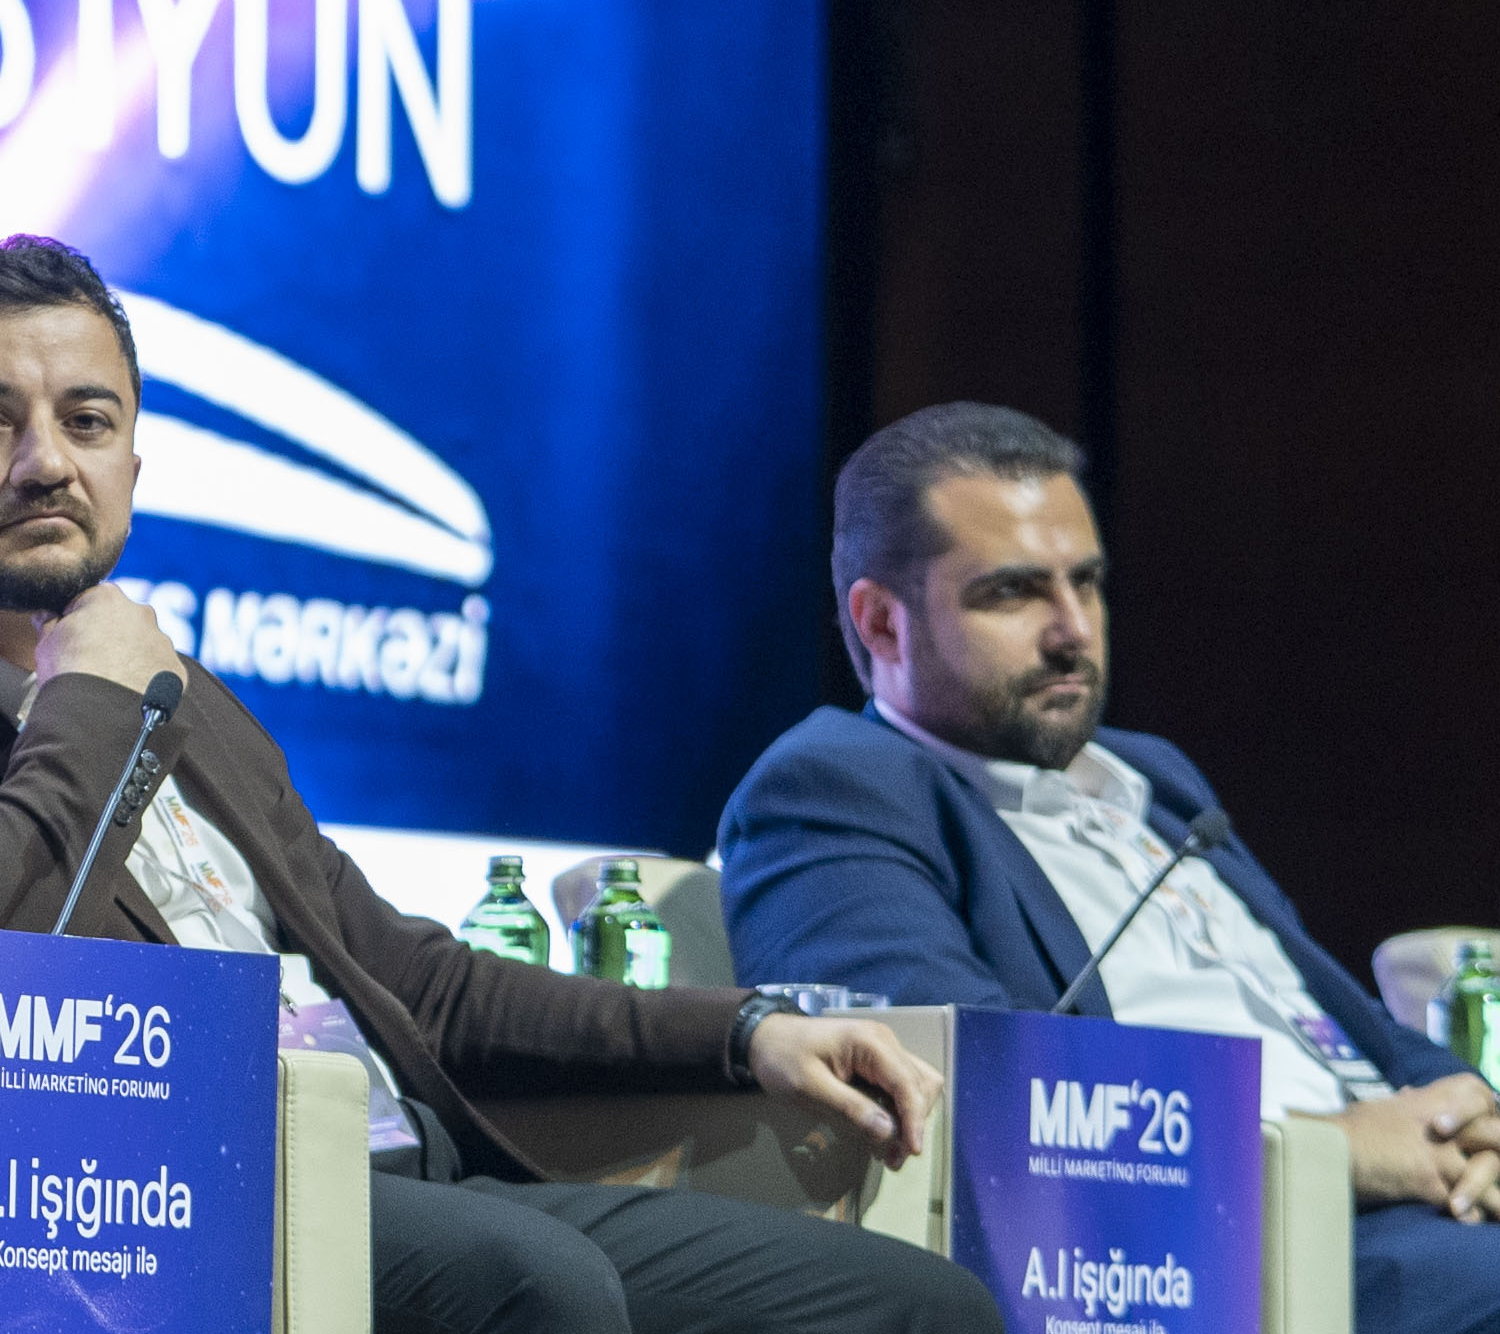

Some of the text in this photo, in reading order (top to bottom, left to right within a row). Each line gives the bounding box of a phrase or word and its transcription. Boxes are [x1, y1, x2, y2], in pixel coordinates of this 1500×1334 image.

[29, 1072, 108, 1096] MARKETİNQ
[112, 1078, 170, 1100] FORUMU
[30, 1157, 192, 1239] işığında
[72, 1245, 131, 1280] mesajı
[136, 1246, 157, 1276] ilə
[1021, 1246, 1193, 1318] A.I işığında
